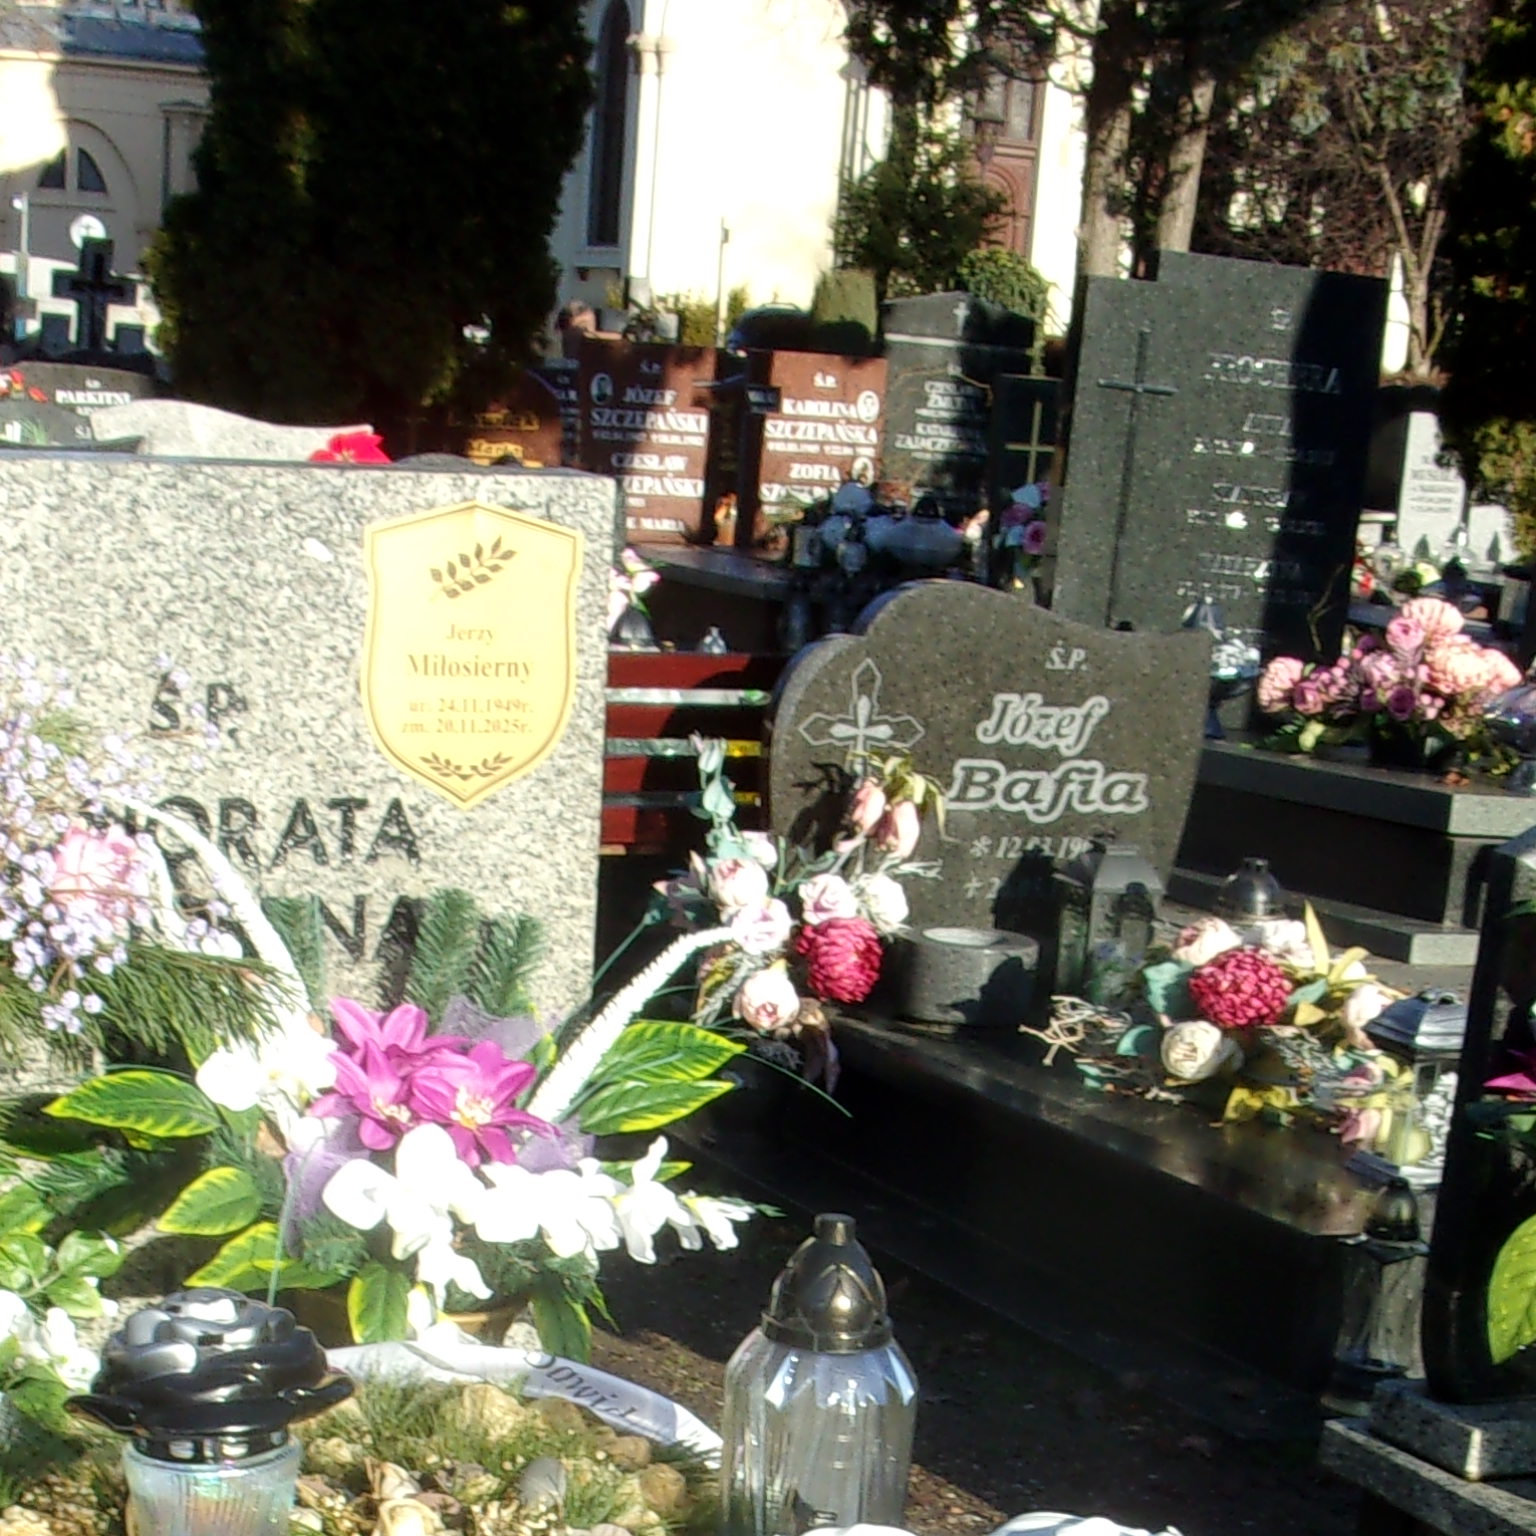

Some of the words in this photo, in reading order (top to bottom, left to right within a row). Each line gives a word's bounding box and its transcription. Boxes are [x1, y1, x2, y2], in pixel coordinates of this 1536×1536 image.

[590, 407, 708, 434] SZCZEPAŃSKI
[781, 398, 858, 420] KAROLINA
[764, 419, 878, 445] SZCZEPAŃSKA
[788, 462, 841, 482] ZOFIA
[446, 624, 495, 645] Jerzy
[407, 653, 535, 685] Miłosierny
[975, 692, 1110, 757] Józef
[943, 757, 1150, 825] Bafia
